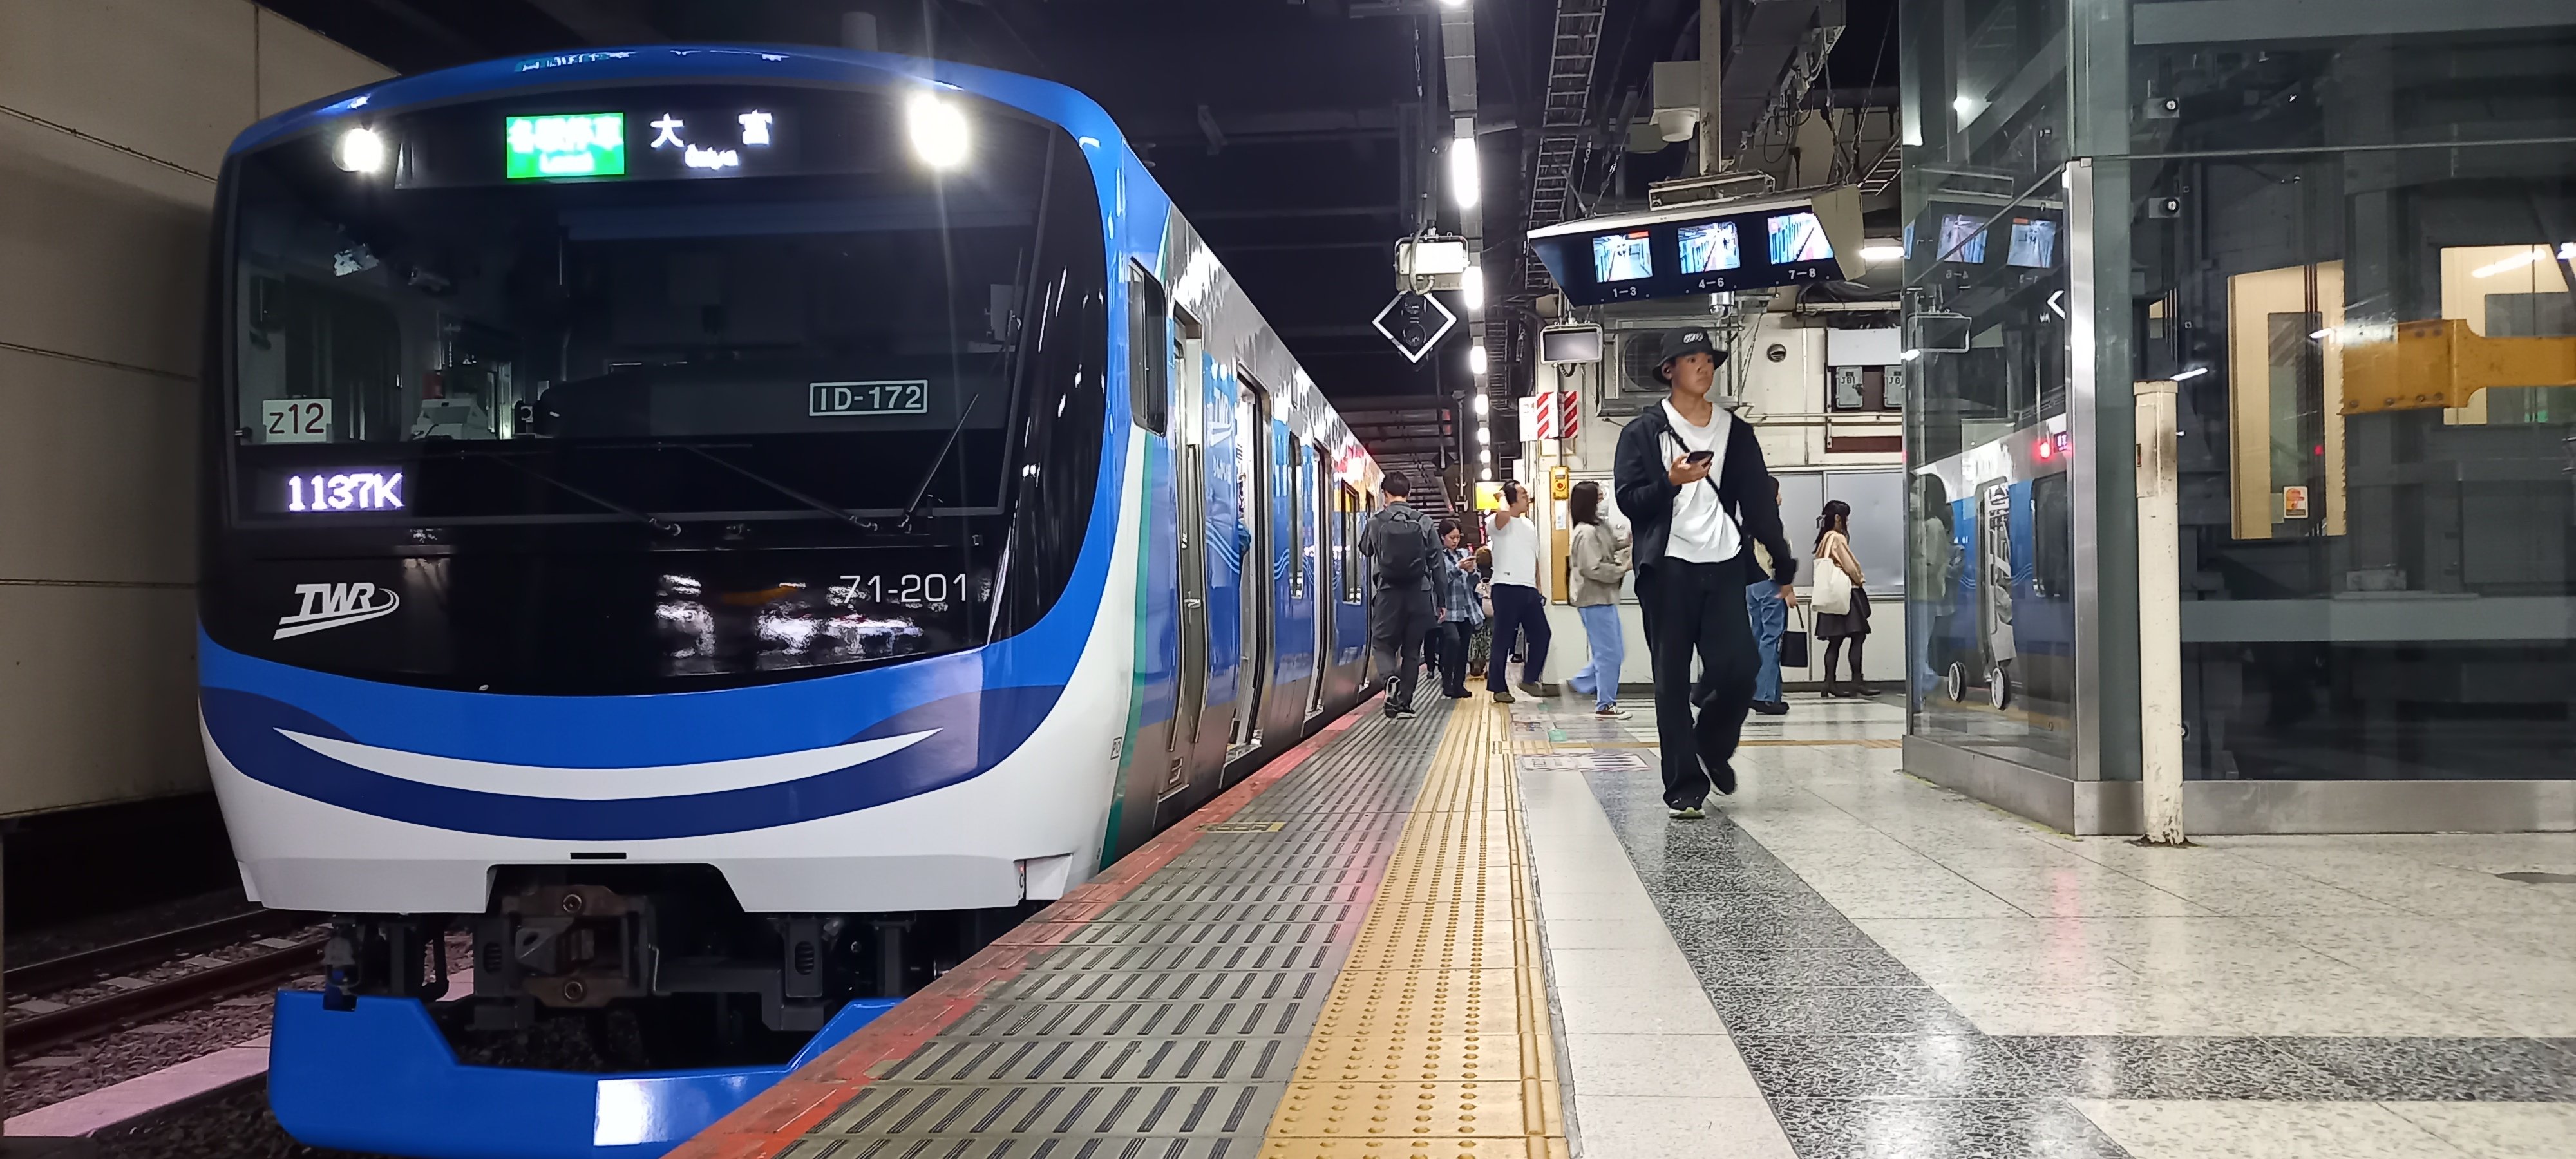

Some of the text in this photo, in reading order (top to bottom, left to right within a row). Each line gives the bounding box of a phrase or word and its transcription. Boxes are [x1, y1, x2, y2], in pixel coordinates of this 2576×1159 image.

[1613, 287, 1637, 298] 1-3
[1698, 278, 1725, 288] 4-6
[820, 386, 922, 411] ID-172
[289, 472, 405, 511] 1137K
[294, 582, 375, 617] TWR
[840, 574, 967, 604] 71-201
